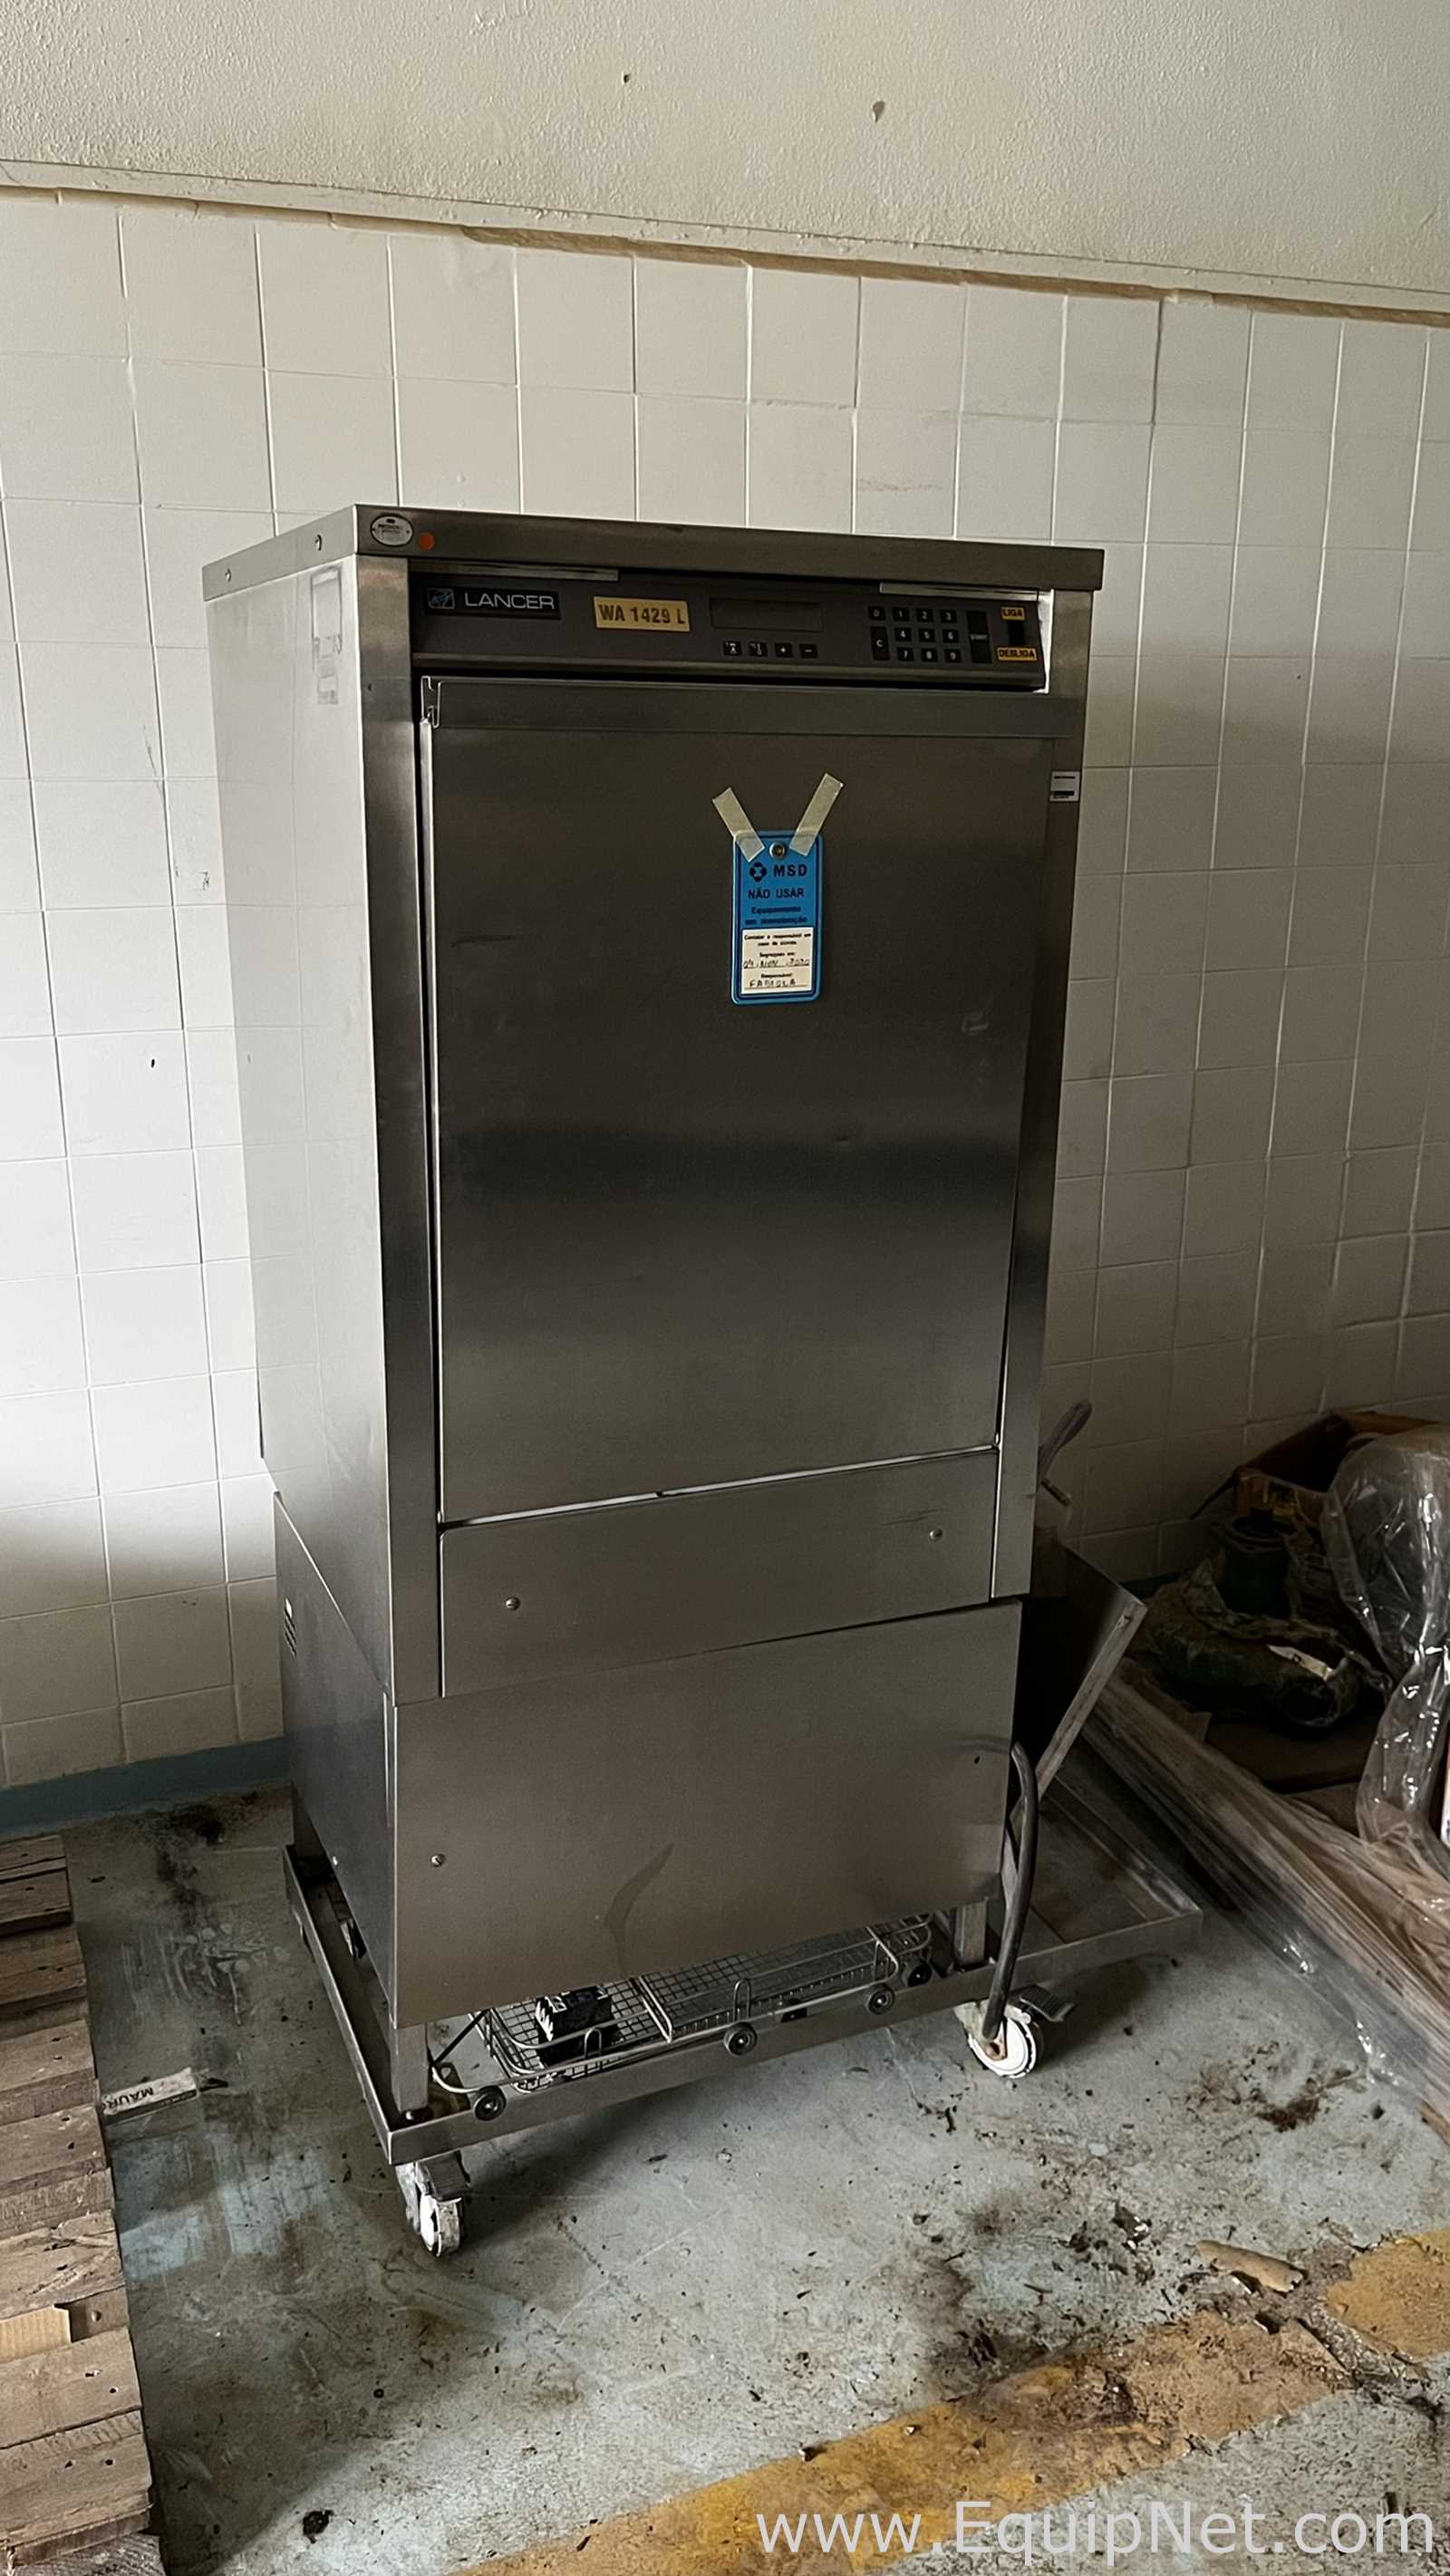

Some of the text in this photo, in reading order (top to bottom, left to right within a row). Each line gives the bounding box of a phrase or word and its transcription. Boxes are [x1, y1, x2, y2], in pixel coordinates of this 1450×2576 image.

[464, 592, 556, 610] LANCER
[598, 603, 686, 623] WA 1429 L
[1003, 608, 1022, 617] LIGA
[773, 863, 807, 877] MSD
[776, 888, 805, 898] USAR
